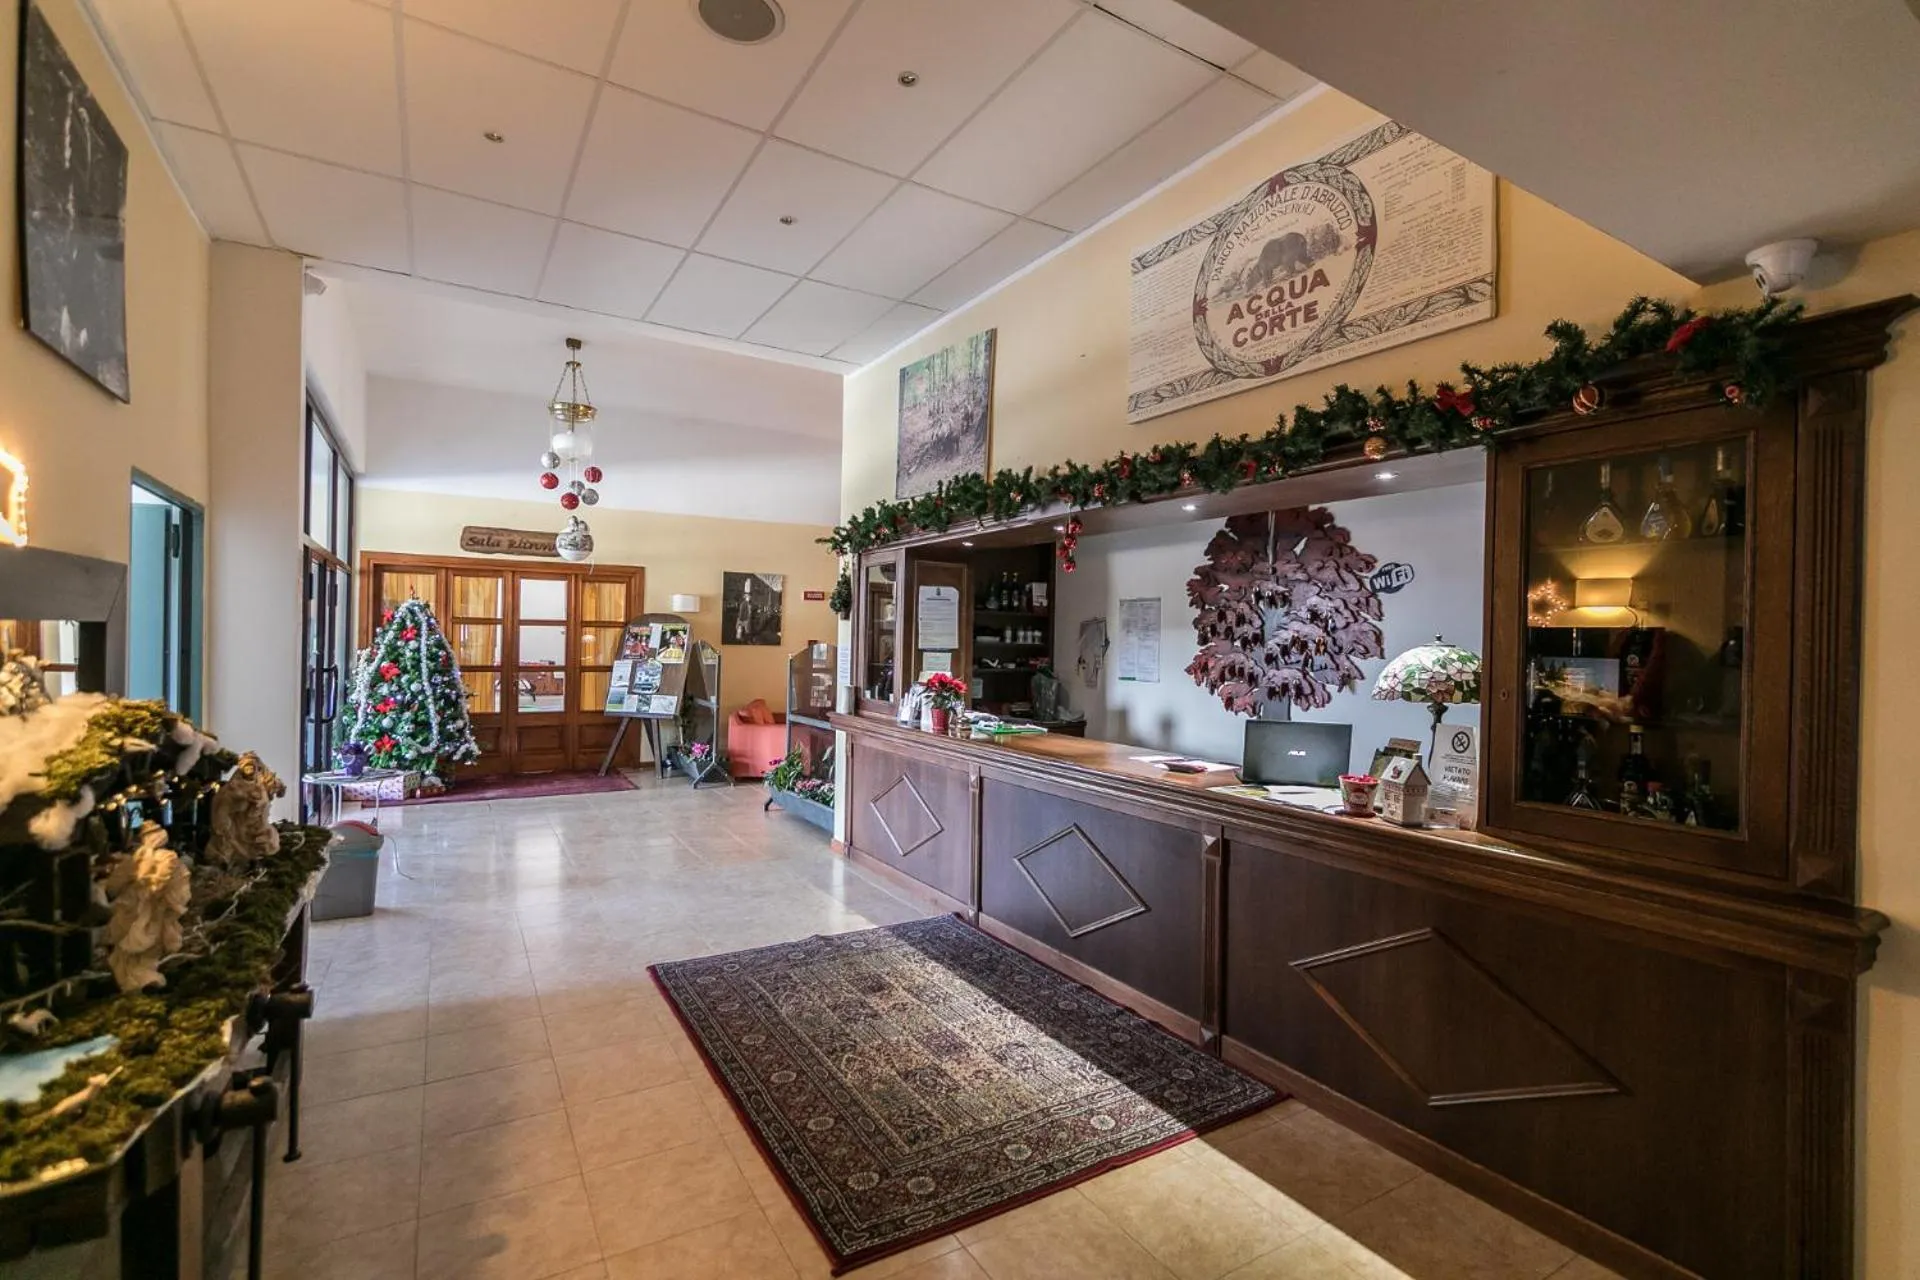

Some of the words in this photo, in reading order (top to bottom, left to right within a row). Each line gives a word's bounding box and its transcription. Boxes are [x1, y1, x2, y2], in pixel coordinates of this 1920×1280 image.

[1234, 186, 1298, 239] NAZIONALE
[1301, 185, 1353, 231] D'ABRUZZO
[1226, 268, 1330, 325] ACQUA
[1255, 301, 1294, 321] DELLA
[1232, 300, 1319, 348] CORTE
